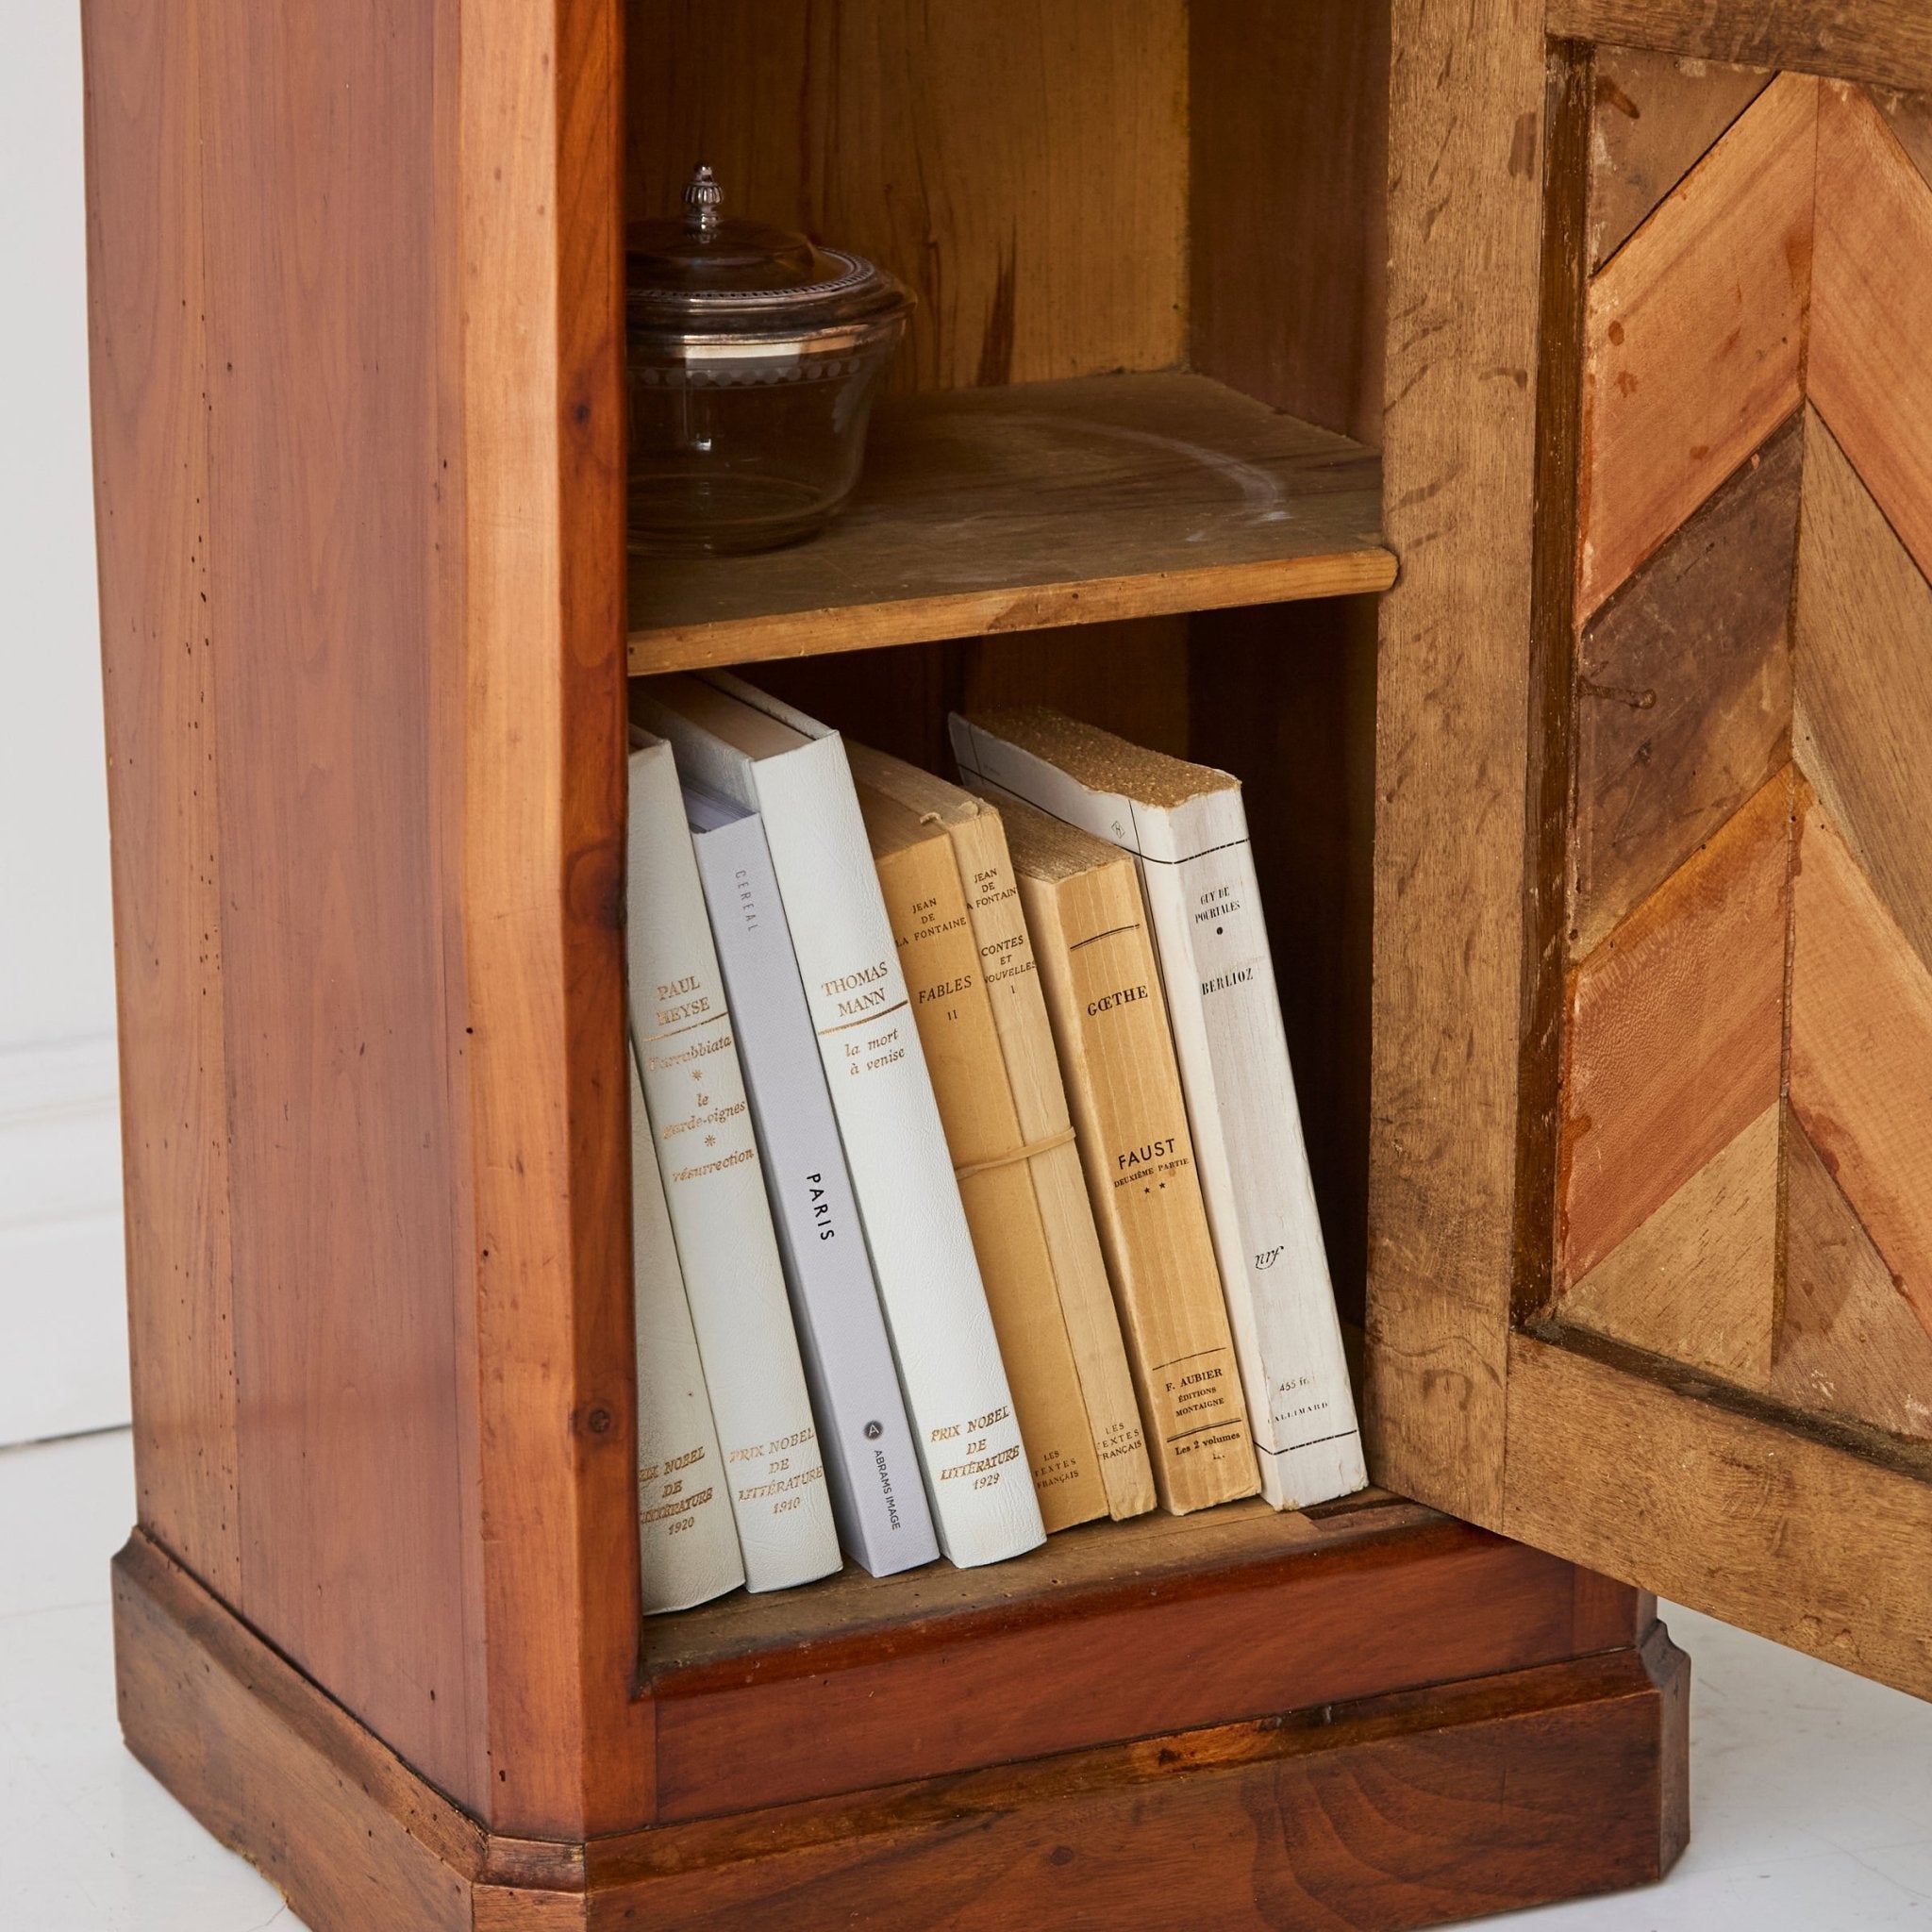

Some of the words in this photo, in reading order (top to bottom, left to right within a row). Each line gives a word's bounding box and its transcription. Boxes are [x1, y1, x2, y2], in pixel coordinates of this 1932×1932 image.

[974, 868, 997, 883] JEAN
[981, 881, 995, 893] DE
[736, 870, 758, 932] CEREAL
[912, 898, 937, 913] JEAN
[975, 887, 1019, 908] FONTAIN
[1200, 891, 1215, 906] GUY
[1218, 886, 1230, 899] DE
[921, 913, 935, 924] DE
[894, 937, 909, 948] LA
[913, 917, 967, 941] FONTAINE
[981, 935, 1024, 957] CONTES
[1000, 954, 1012, 965] ET
[657, 975, 700, 1001] PAUL
[821, 961, 888, 996] THOMAS
[918, 975, 973, 1004] FABLES
[1202, 968, 1254, 995] BERLIOZ
[657, 996, 710, 1027] HEYSE
[838, 988, 886, 1017] MANN
[1087, 985, 1148, 1016] GŒTHE
[844, 1043, 860, 1058] la
[867, 1027, 899, 1051] mort
[850, 1062, 860, 1075] à
[866, 1047, 906, 1071] venise
[696, 1092, 709, 1108] le
[672, 1148, 755, 1183] résurrection
[1118, 1138, 1174, 1170] FAUST
[1158, 1158, 1191, 1172] PARTIE
[807, 1173, 835, 1241] PARIS
[1254, 1245, 1285, 1270] nrf
[1166, 1382, 1175, 1392] F.
[1180, 1368, 1224, 1388] AUBIER
[1175, 1397, 1224, 1417] MONTAIGNE
[1177, 1386, 1217, 1403] ÉDITIONS
[930, 1424, 960, 1442] PRIX
[967, 1405, 1010, 1434] NOBEL
[1106, 1423, 1124, 1435] LES
[729, 1444, 764, 1463] PRIX
[768, 1427, 815, 1455] NOBEL
[966, 1439, 987, 1455] DE
[1097, 1428, 1140, 1450] EXTES
[1174, 1443, 1191, 1456] Les
[1193, 1439, 1199, 1450] 2
[1202, 1430, 1241, 1447] volumes
[663, 1446, 706, 1475] NOBEL
[768, 1458, 790, 1474] DE
[940, 1445, 1021, 1481] LITTÉRATURE
[1043, 1450, 1060, 1461] LES
[662, 1480, 682, 1498] DE
[739, 1466, 824, 1504] LITTÉRATURE
[874, 1449, 892, 1494] ABRAMS
[885, 1496, 901, 1530] IMAGE
[973, 1473, 1001, 1491] 1929
[668, 1516, 695, 1536] 1920
